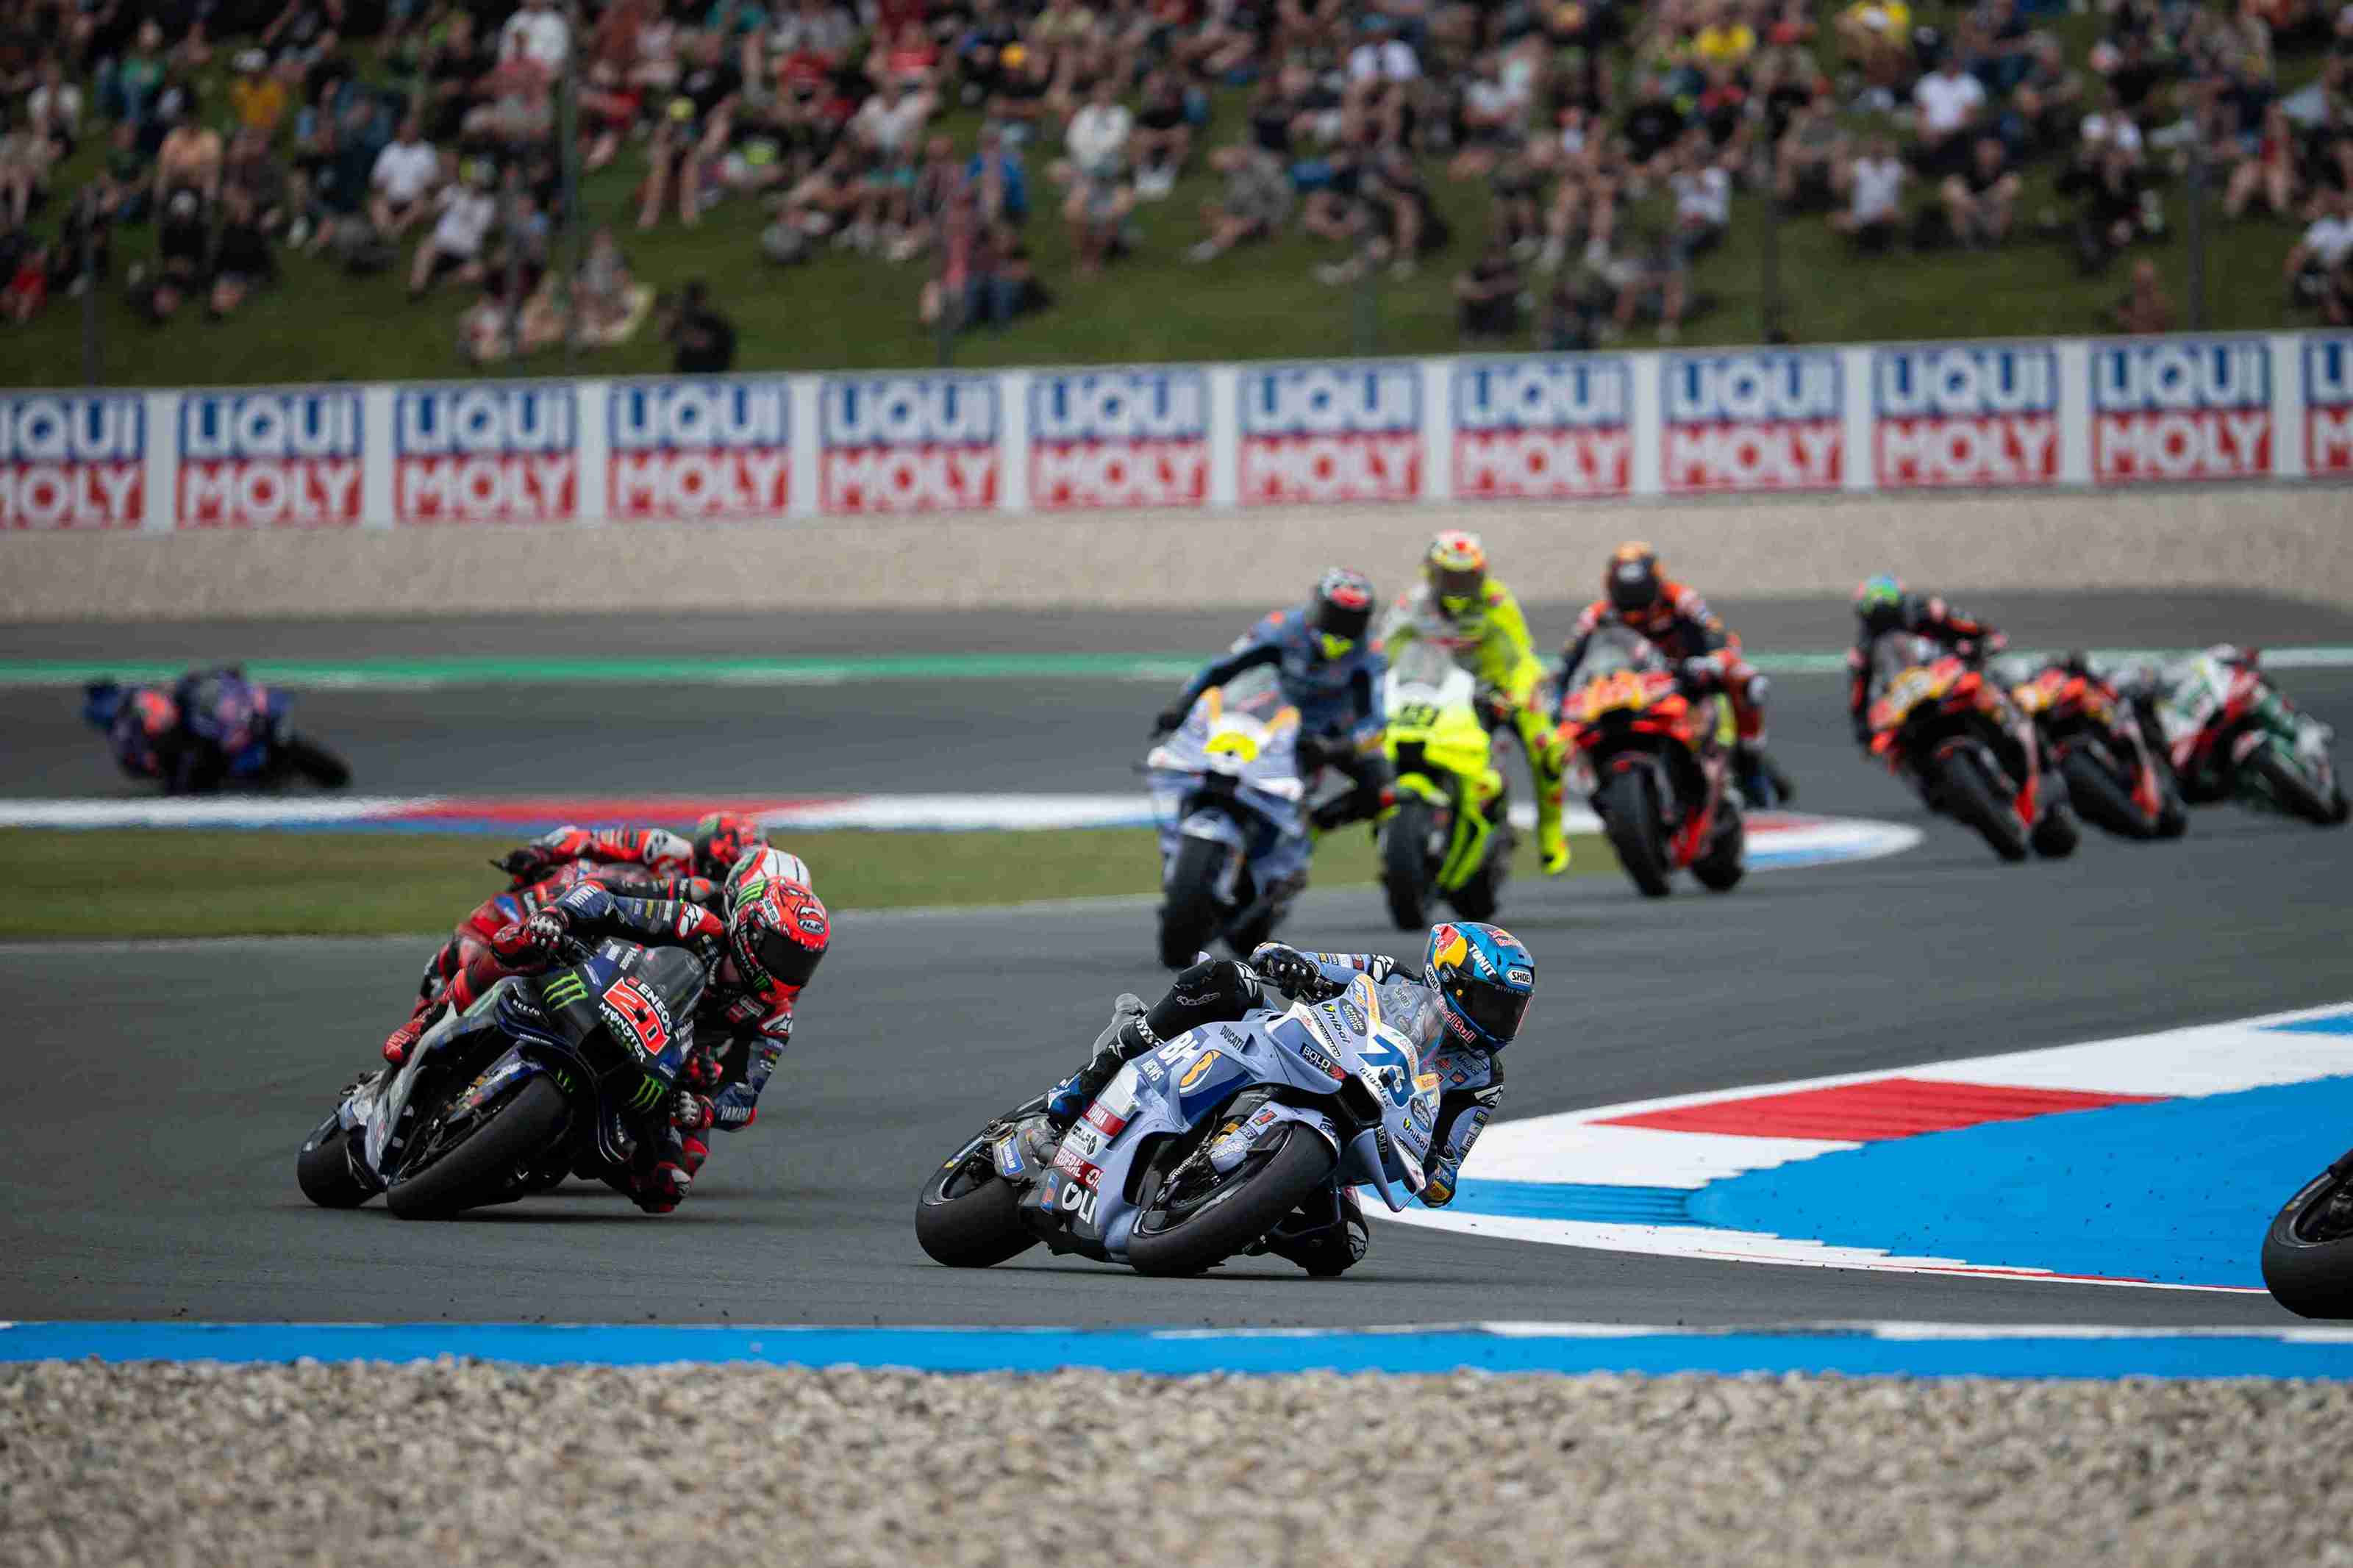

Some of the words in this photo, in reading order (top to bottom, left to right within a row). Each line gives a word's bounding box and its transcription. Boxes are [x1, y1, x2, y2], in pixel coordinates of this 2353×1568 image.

[1036, 375, 1202, 438] LIQUI
[1246, 370, 1415, 433] LIQUI
[1459, 364, 1627, 426] LIQUI
[1669, 357, 1836, 420] LIQUI
[1879, 350, 2053, 413] LIQUI
[2097, 343, 2267, 409] LIQUI
[182, 395, 357, 458] LIQUI
[401, 390, 571, 453] LIQUI
[615, 385, 785, 448] LIQUI
[826, 380, 994, 444] LIQUI
[1037, 440, 1203, 507] MOLY
[1246, 435, 1415, 501] MOLY
[1460, 429, 1628, 495] MOLY
[1670, 423, 1837, 488] MOLY
[1880, 415, 2054, 481] MOLY
[2098, 411, 2268, 477] MOLY
[183, 460, 357, 523] MOLY
[401, 455, 572, 520] MOLY
[615, 450, 785, 515] MOLY
[827, 446, 995, 512] MOLY
[1425, 965, 1441, 993] SHOEI
[1468, 942, 1496, 978] TONIT
[602, 976, 671, 1056] 20
[638, 982, 673, 1034] ENEOS
[1219, 1025, 1244, 1051] DUCATI
[1321, 1002, 1352, 1044] Unibat
[1141, 1058, 1165, 1082] NEWS
[1302, 1045, 1331, 1069] BOLD
[1376, 1124, 1388, 1153] BOLD
[1402, 1117, 1429, 1151] Unibat
